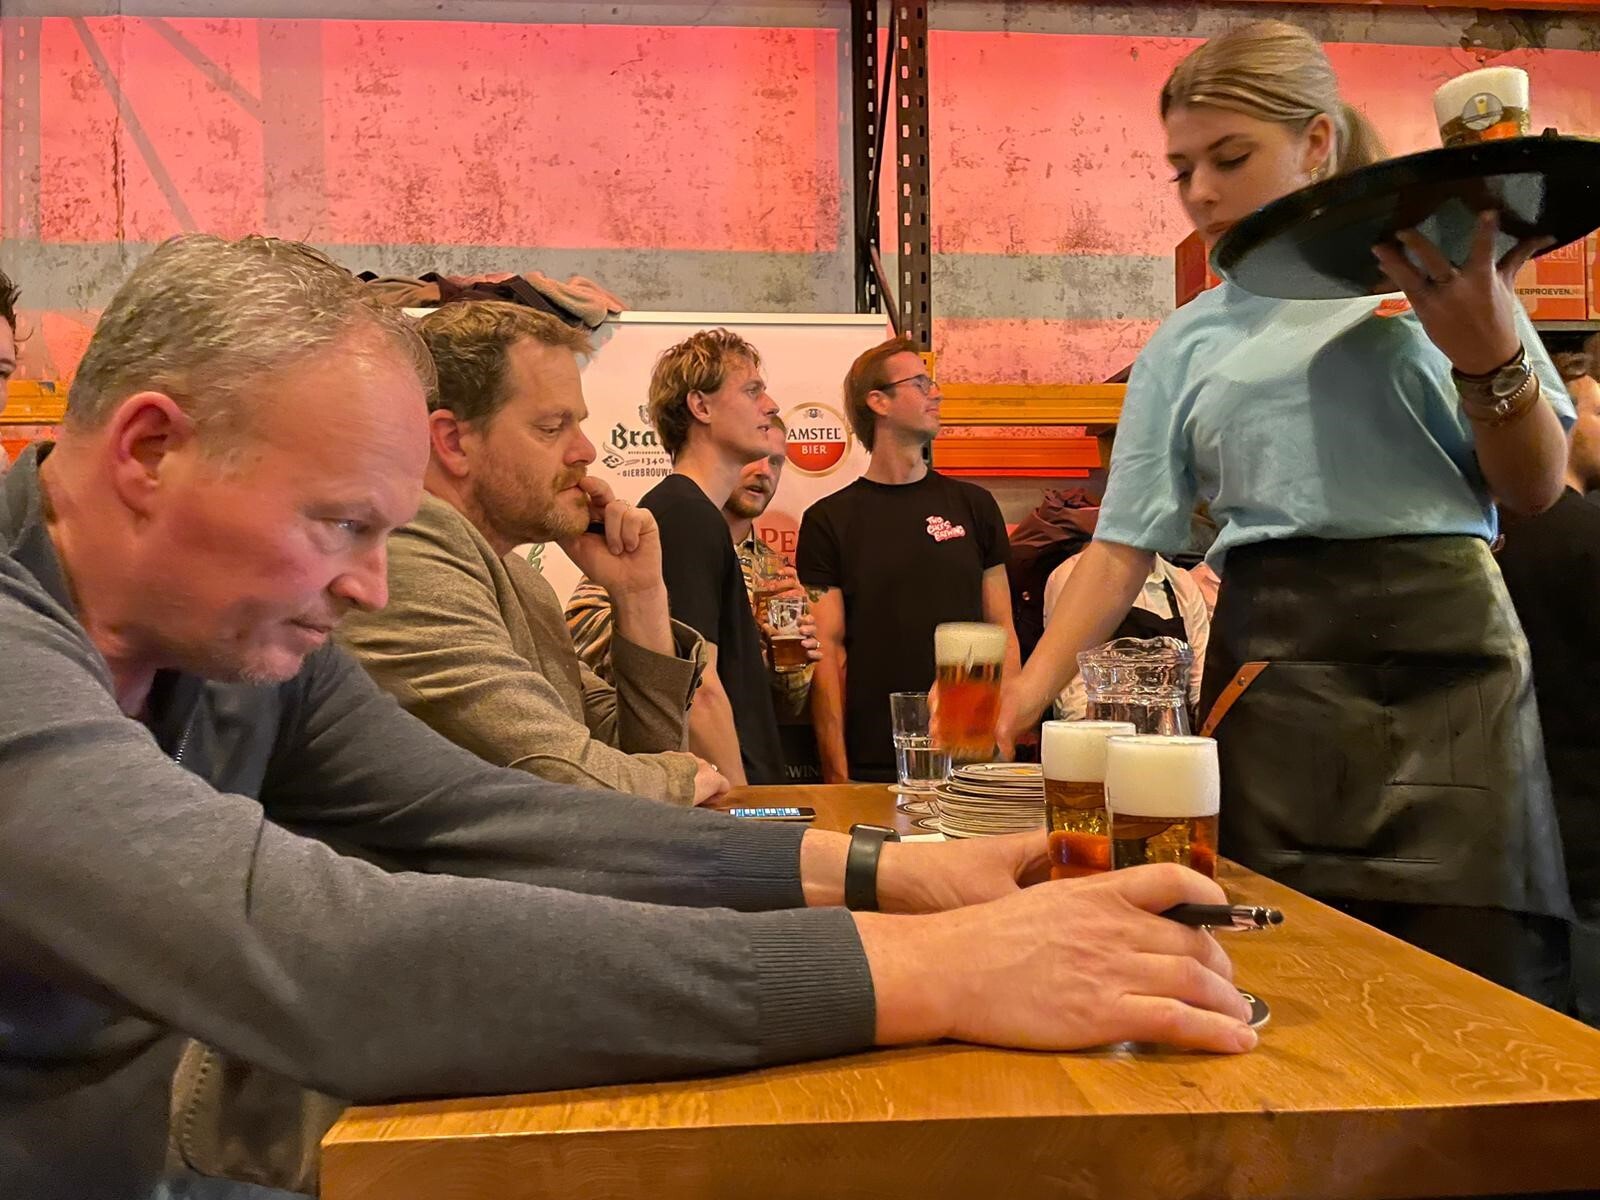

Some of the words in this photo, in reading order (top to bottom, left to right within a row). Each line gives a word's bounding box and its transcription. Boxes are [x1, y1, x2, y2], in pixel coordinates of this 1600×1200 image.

[611, 423, 659, 450] Bra
[787, 427, 842, 440] AMSTEL
[801, 444, 828, 455] BIER
[641, 457, 665, 466] 1340
[622, 468, 673, 478] BIERBROUWE
[760, 527, 796, 553] PE
[784, 764, 820, 778] WIN
